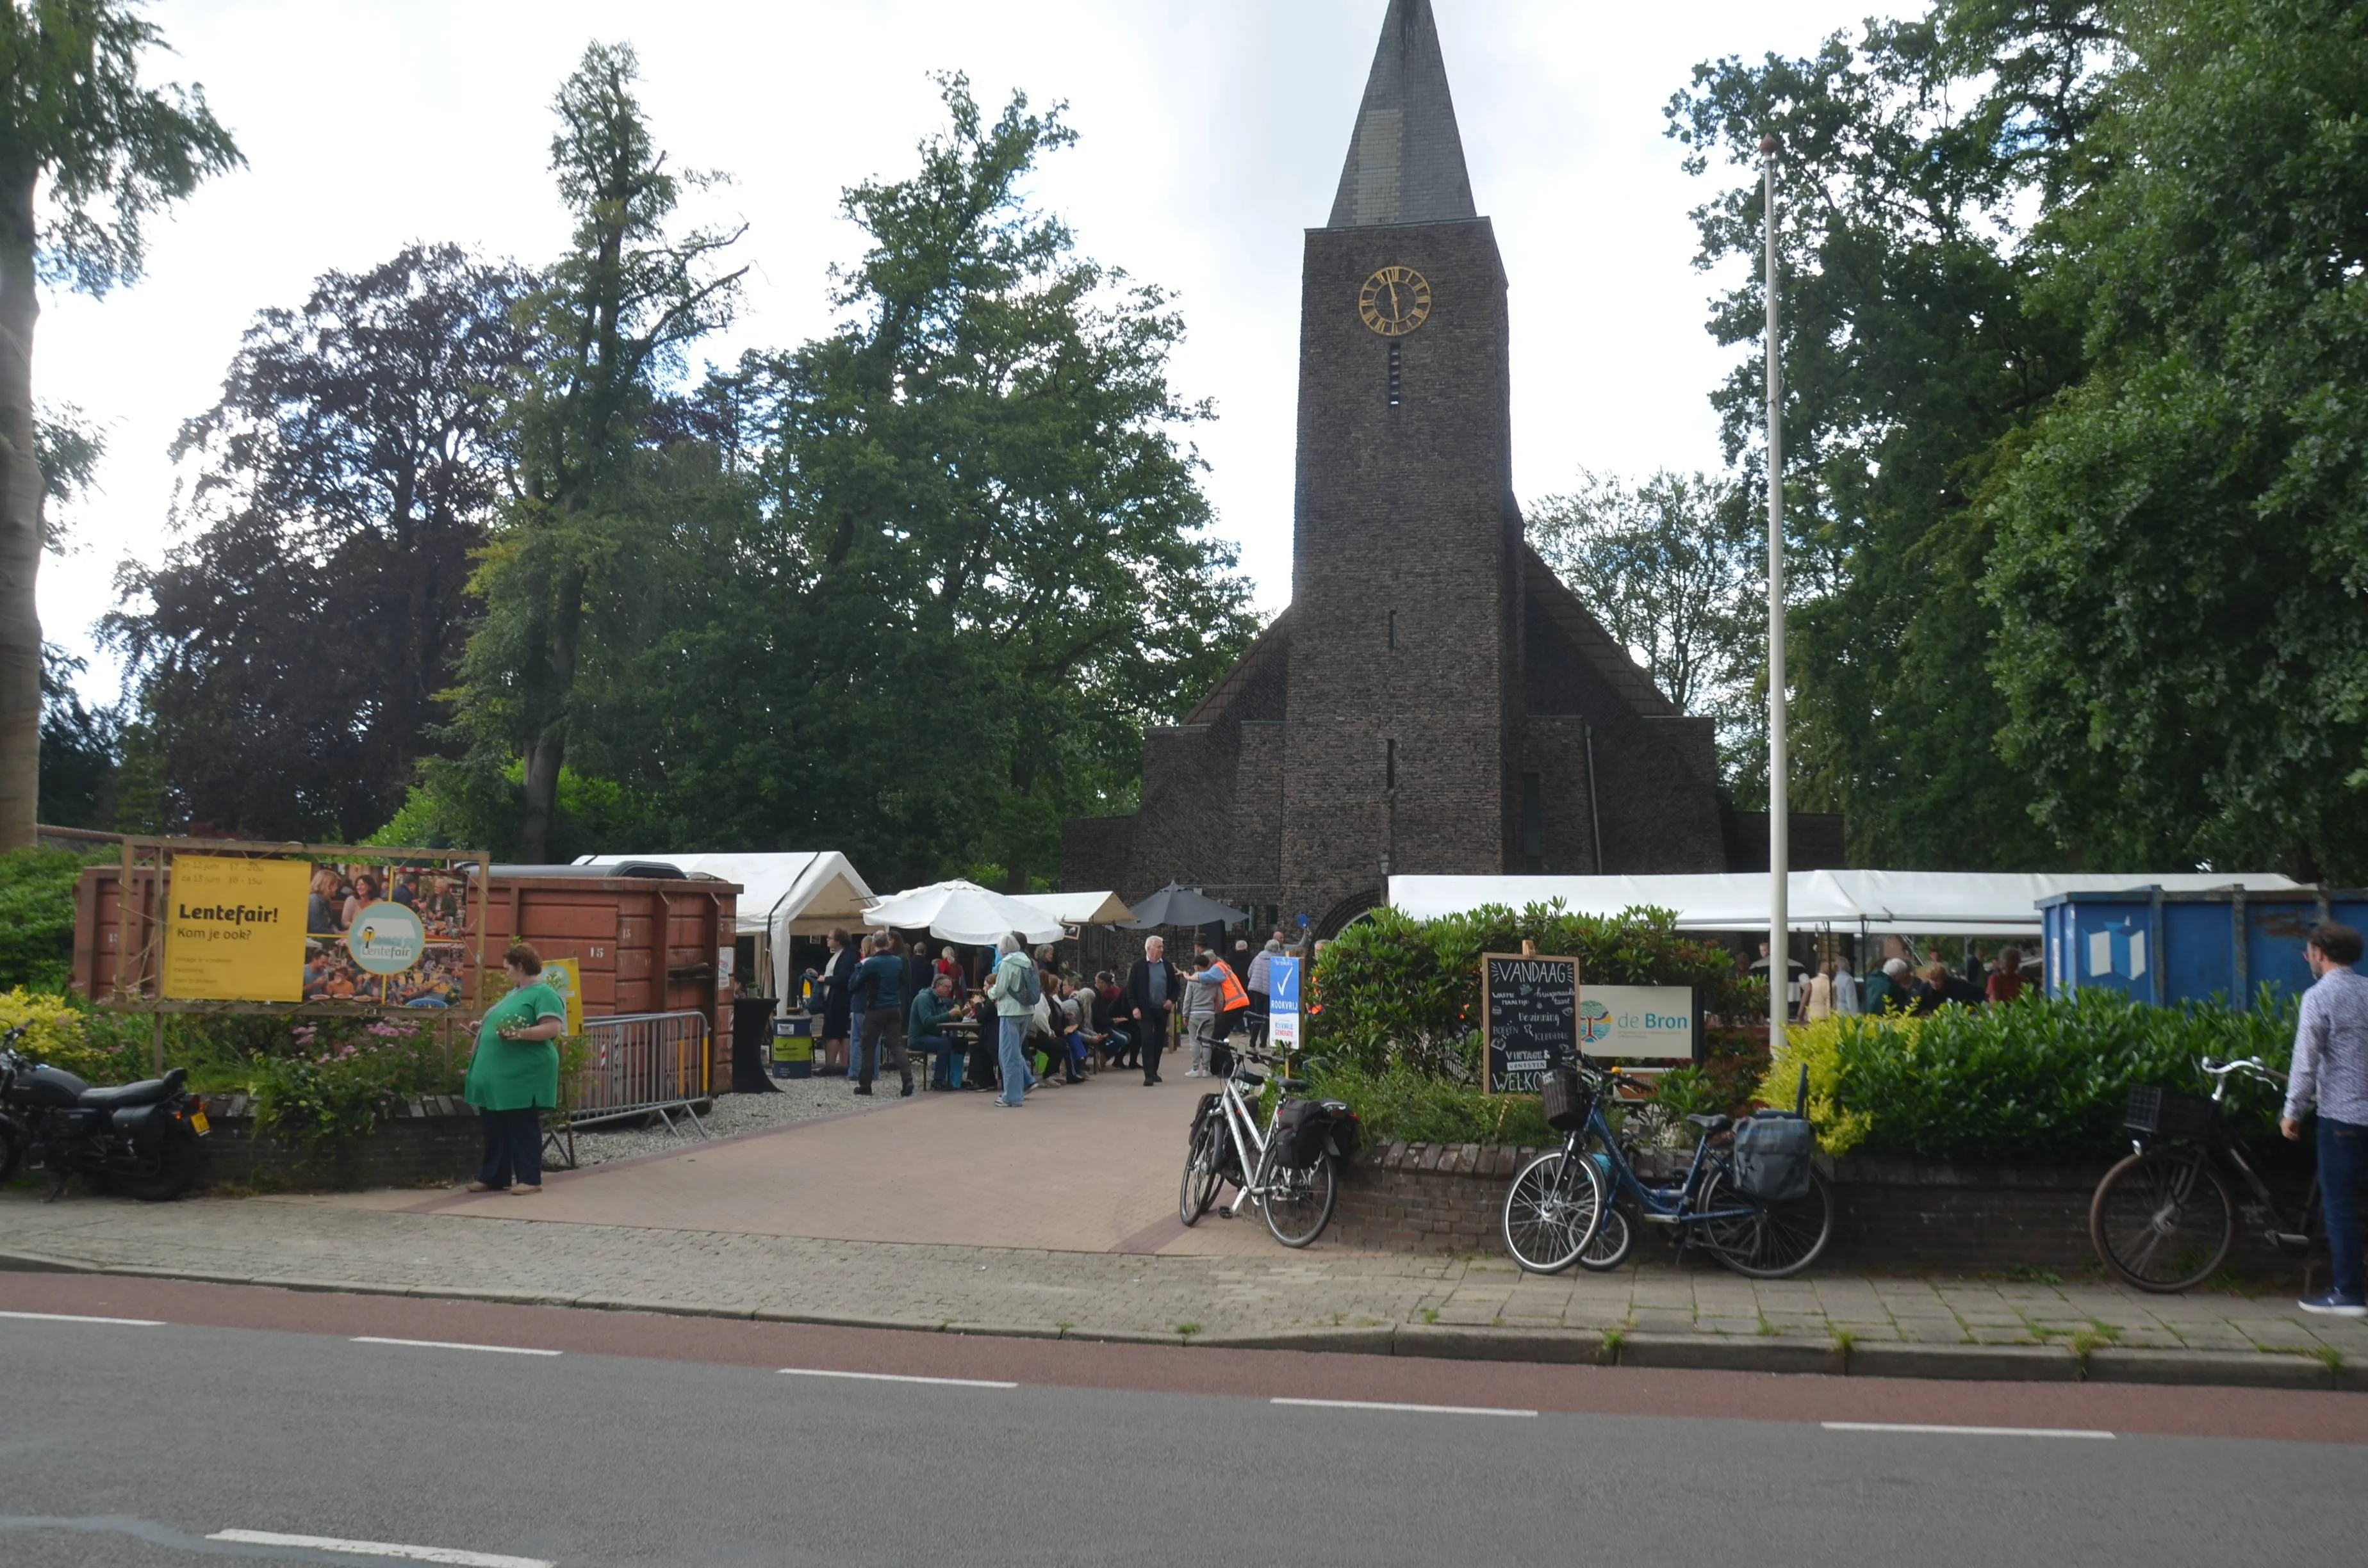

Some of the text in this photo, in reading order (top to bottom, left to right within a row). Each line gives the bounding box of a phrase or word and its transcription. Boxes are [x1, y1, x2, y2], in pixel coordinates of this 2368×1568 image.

[179, 903, 279, 926] Lentefair!
[177, 927, 252, 942] Kom je ook?
[622, 928, 632, 939] 15
[361, 945, 411, 959] Lentefair
[589, 946, 604, 959] 15
[1497, 961, 1566, 984] VANDAAG
[1270, 999, 1298, 1011] ROOKVRIJ
[1618, 1012, 1688, 1029] de Bron
[1534, 1032, 1570, 1042] KLEDING
[1506, 1049, 1551, 1061] VINTAGE &
[1492, 1071, 1545, 1091] WELKO
